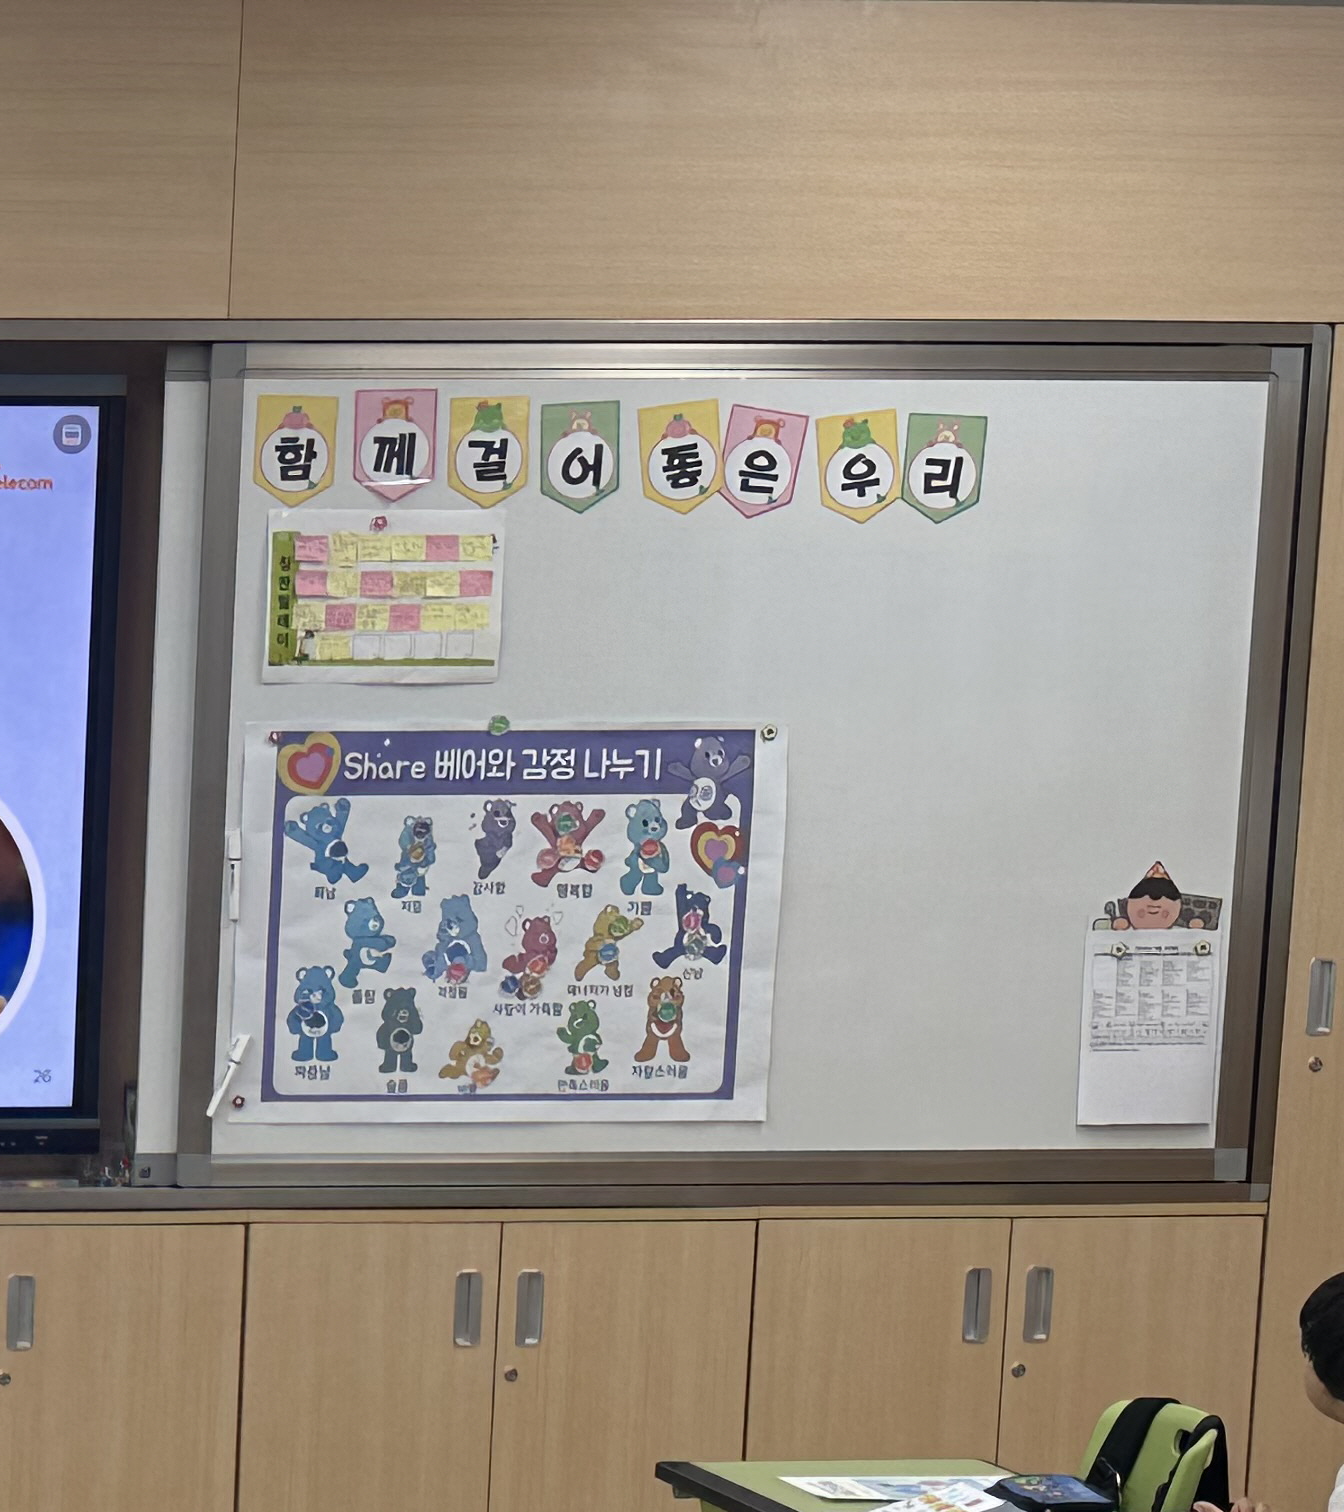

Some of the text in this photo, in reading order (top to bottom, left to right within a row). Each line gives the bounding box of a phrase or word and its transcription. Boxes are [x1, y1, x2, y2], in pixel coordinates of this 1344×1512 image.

[344, 747, 663, 783] Share 베어와 감정 나누기
